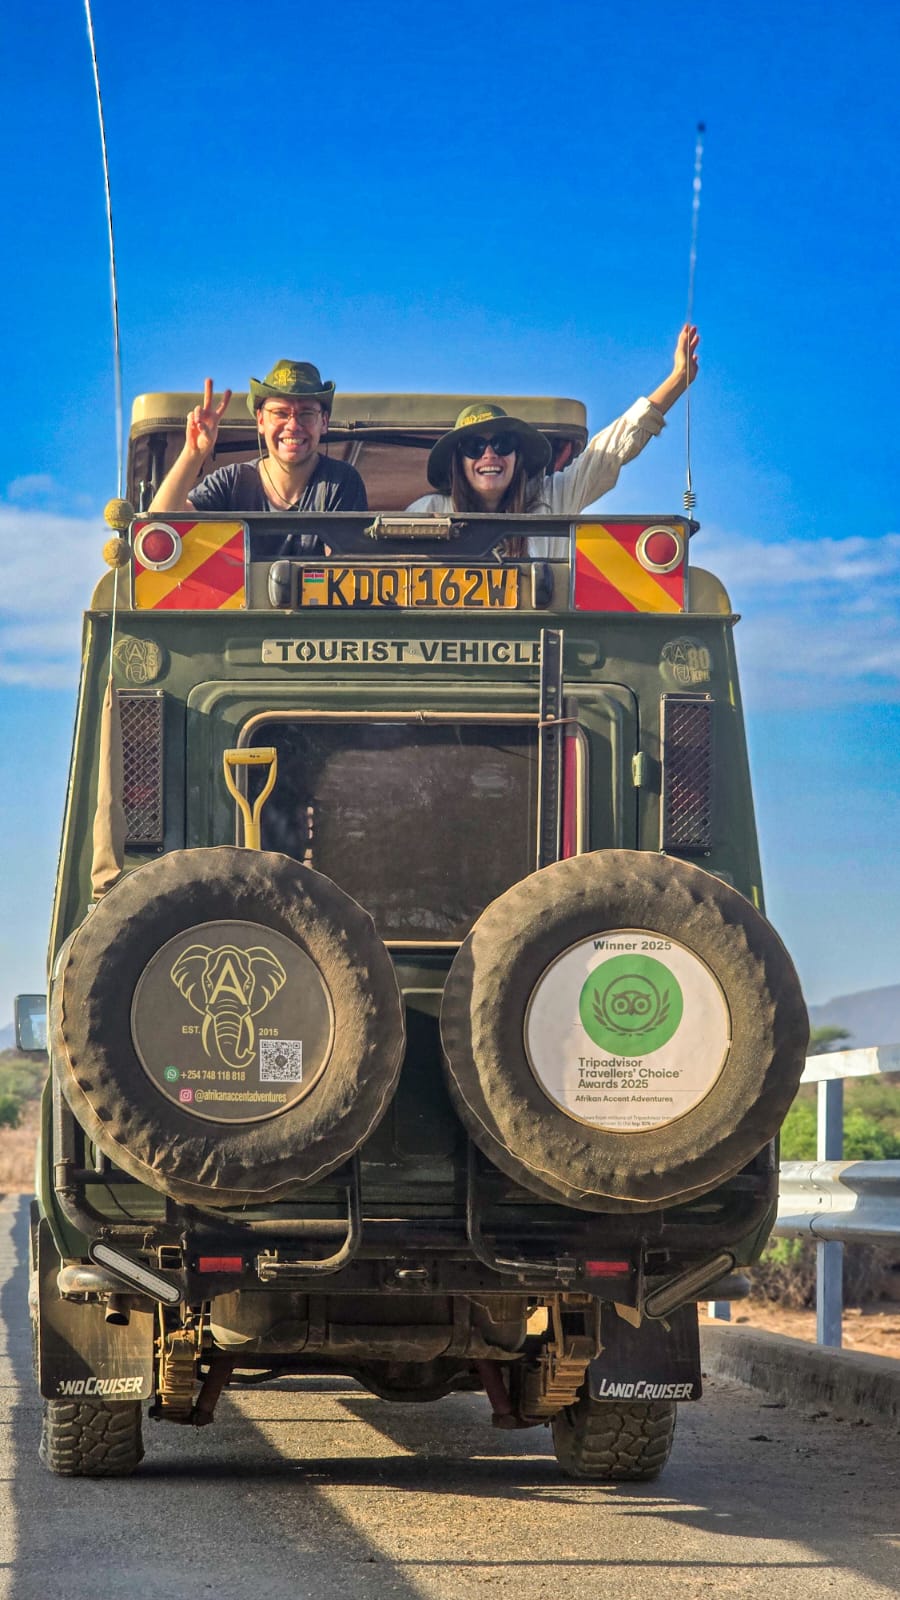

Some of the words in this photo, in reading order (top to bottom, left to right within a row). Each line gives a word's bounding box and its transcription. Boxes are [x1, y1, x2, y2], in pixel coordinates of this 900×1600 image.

[327, 569, 399, 606] KDQ
[415, 568, 508, 606] 162W
[276, 641, 409, 662] TOURIST
[593, 940, 637, 950] Winner
[641, 940, 672, 950] 2025
[182, 1025, 201, 1035] EST.
[258, 1027, 279, 1036] 2015
[578, 1057, 643, 1069] Tripadvisor
[180, 1069, 201, 1080] +254
[578, 1068, 636, 1078] Travellers'
[577, 1079, 618, 1089] Awards
[621, 1079, 649, 1089] 2025
[575, 1095, 602, 1103] Afrikan
[603, 1095, 629, 1103] Accent
[631, 1095, 674, 1103] Adventures
